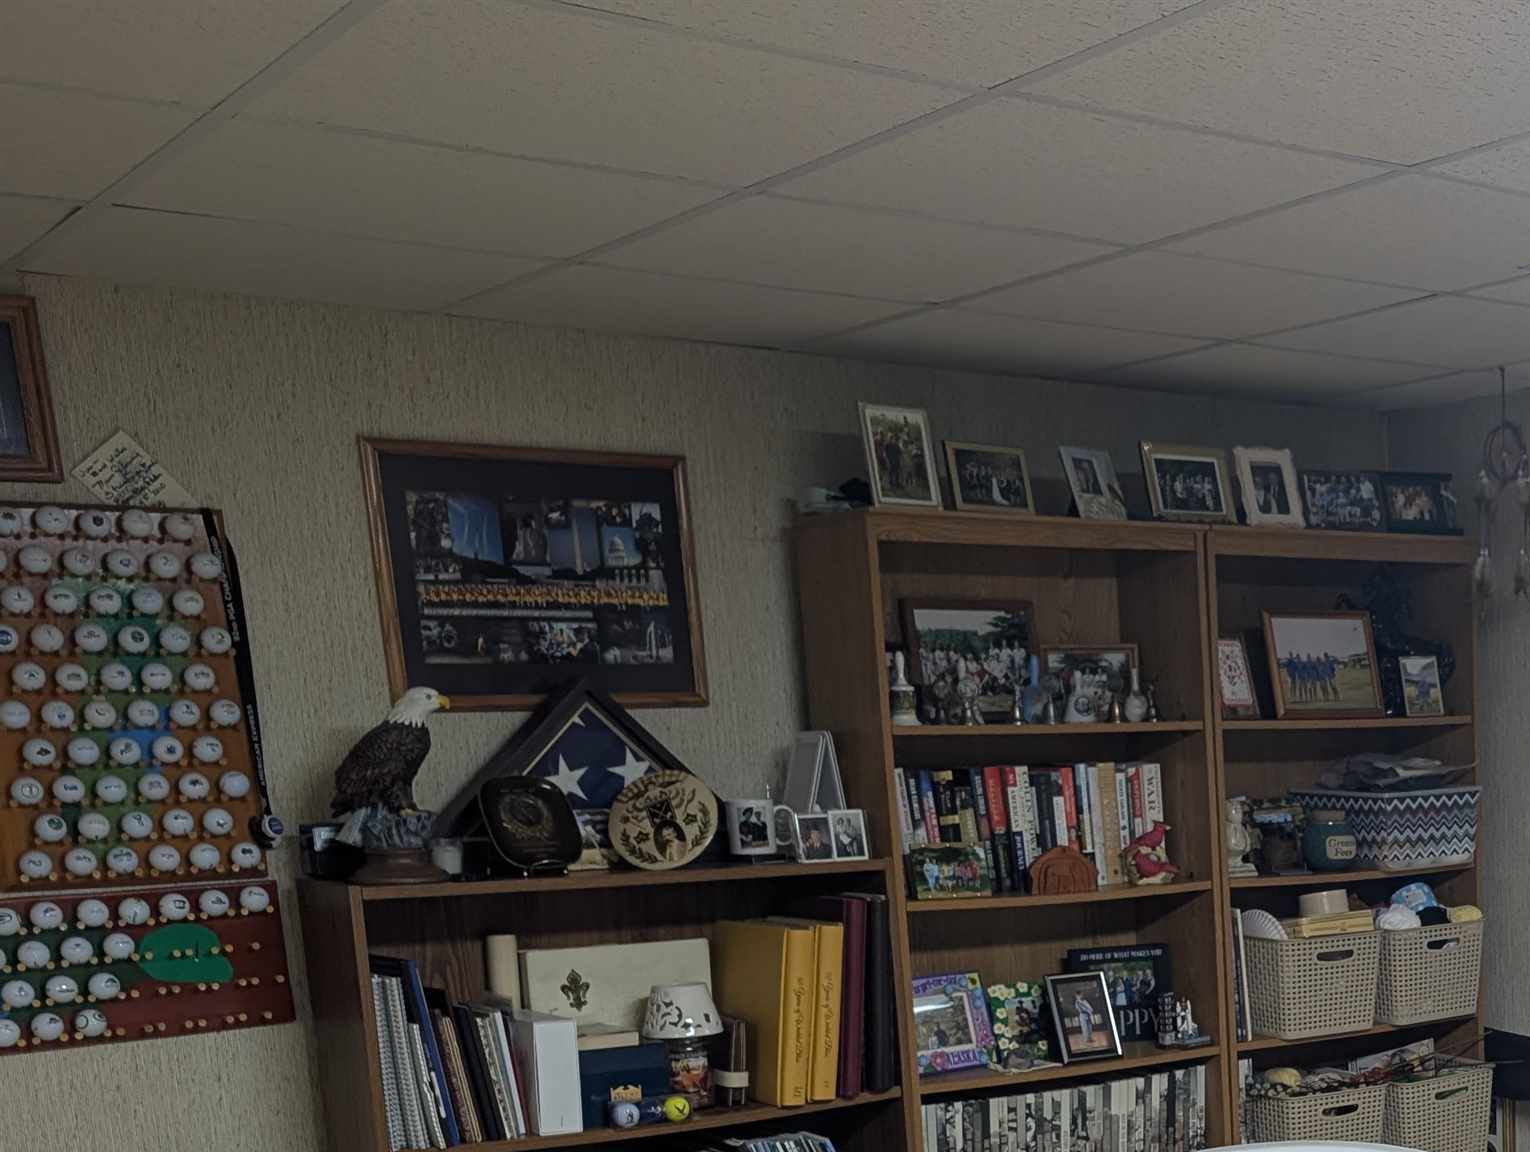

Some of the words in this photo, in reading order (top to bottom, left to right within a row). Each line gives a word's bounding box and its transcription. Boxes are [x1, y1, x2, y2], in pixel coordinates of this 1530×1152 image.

[1010, 790, 1020, 829] AMERICAN
[1146, 776, 1157, 812] WAR
[1119, 1007, 1160, 1036] PPY
